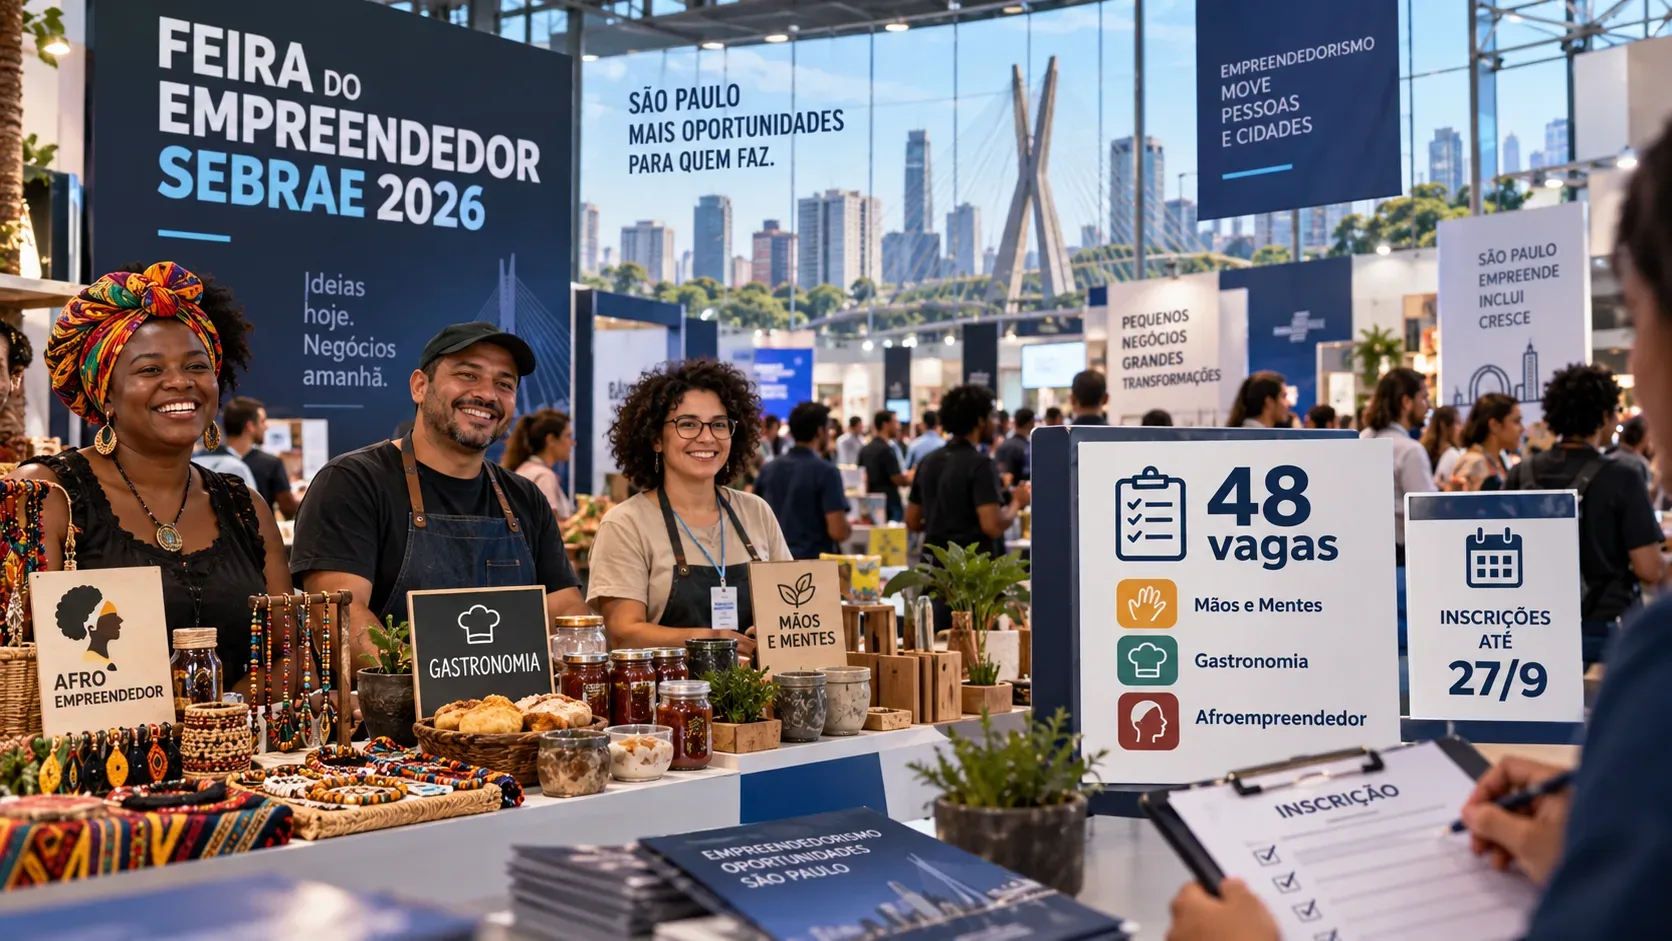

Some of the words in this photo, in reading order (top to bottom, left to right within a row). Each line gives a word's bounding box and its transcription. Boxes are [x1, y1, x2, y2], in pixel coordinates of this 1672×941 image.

[158, 16, 313, 93] FEIRA
[324, 69, 361, 101] DO
[1220, 36, 1375, 78] EMPREENDEDORISMO
[629, 86, 667, 115] SÃO
[675, 83, 740, 113] PAULO
[1221, 77, 1271, 102] MOVE
[1221, 94, 1300, 125] PESSOAS
[158, 80, 541, 183] EMPREENDEDOR
[629, 121, 676, 146] MAIS
[682, 109, 845, 142] OPORTUNIDADES
[1222, 131, 1232, 148] E
[1236, 116, 1313, 146] CIDADES
[629, 153, 674, 175] PARA
[679, 149, 731, 174] QUEM
[737, 147, 775, 168] FAZ.
[157, 145, 365, 218] SEBRAE
[377, 173, 485, 231] 2026
[1478, 248, 1507, 266] SÃO
[1510, 242, 1557, 263] PAULO
[304, 271, 365, 298] Ideias
[1479, 264, 1560, 287] EMPREENDE
[1479, 290, 1524, 308] INCLUI
[304, 302, 354, 330] hoje.
[1122, 308, 1190, 330] PEQUENOS
[1479, 311, 1531, 329] CRESCE
[303, 333, 397, 363] Negócios
[1122, 329, 1187, 351] NEGÓCIOS
[1122, 350, 1184, 371] GRANDES
[303, 365, 388, 388] amanhã.
[1122, 368, 1221, 390] TRANSFORMAÇÕES
[1207, 464, 1311, 527] 48
[1208, 531, 1339, 570] vagas
[1194, 596, 1240, 613] Mãos
[1244, 601, 1255, 613] e
[1259, 598, 1323, 613] Mentes
[1440, 607, 1551, 628] INSCRIÇÕES
[779, 611, 821, 631] MÃOS
[768, 634, 777, 649] E
[780, 630, 836, 648] MENTES
[1478, 631, 1513, 649] ATÉ
[429, 652, 541, 680] GASTRONOMIA
[1194, 652, 1309, 670] Gastronomia
[54, 670, 106, 691] AFRO
[1448, 658, 1548, 702] 27/9
[55, 685, 164, 709] EMPREENDEDOR
[1195, 709, 1367, 730] Afroempreendedor
[1274, 784, 1400, 819] INSCRIÇÃO
[702, 828, 882, 862] EMPREENDEDORISMO
[721, 843, 871, 874] OPORTUNIDADES
[741, 869, 785, 888] SÃO
[786, 862, 850, 882] PAULO
